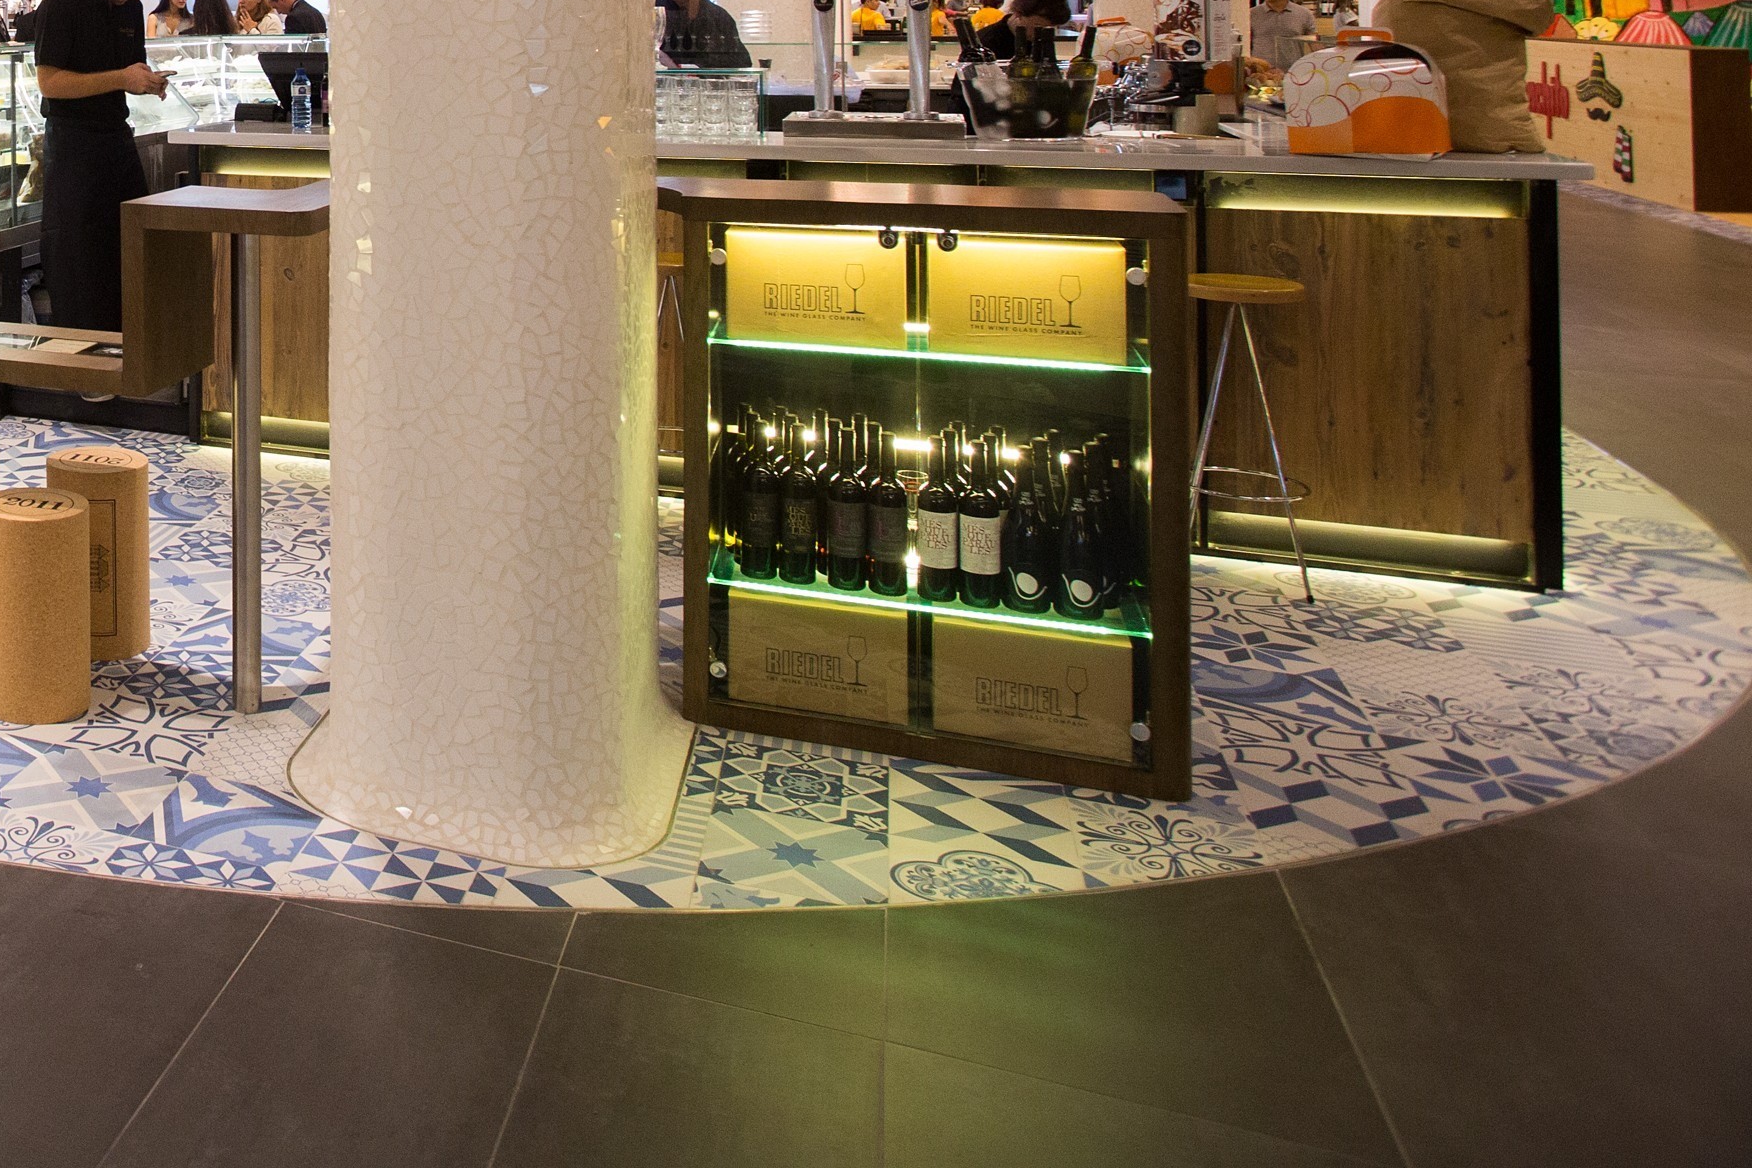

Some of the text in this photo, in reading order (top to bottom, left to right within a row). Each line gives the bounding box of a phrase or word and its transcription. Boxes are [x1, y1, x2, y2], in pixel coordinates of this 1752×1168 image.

[763, 282, 842, 313] RIEDEL
[970, 294, 1056, 326] RIEDEL
[1041, 328, 1082, 336] COMPANY
[2, 496, 66, 511] 2011
[765, 647, 844, 684] RIEDEL
[975, 676, 1063, 717] RIEDEL
